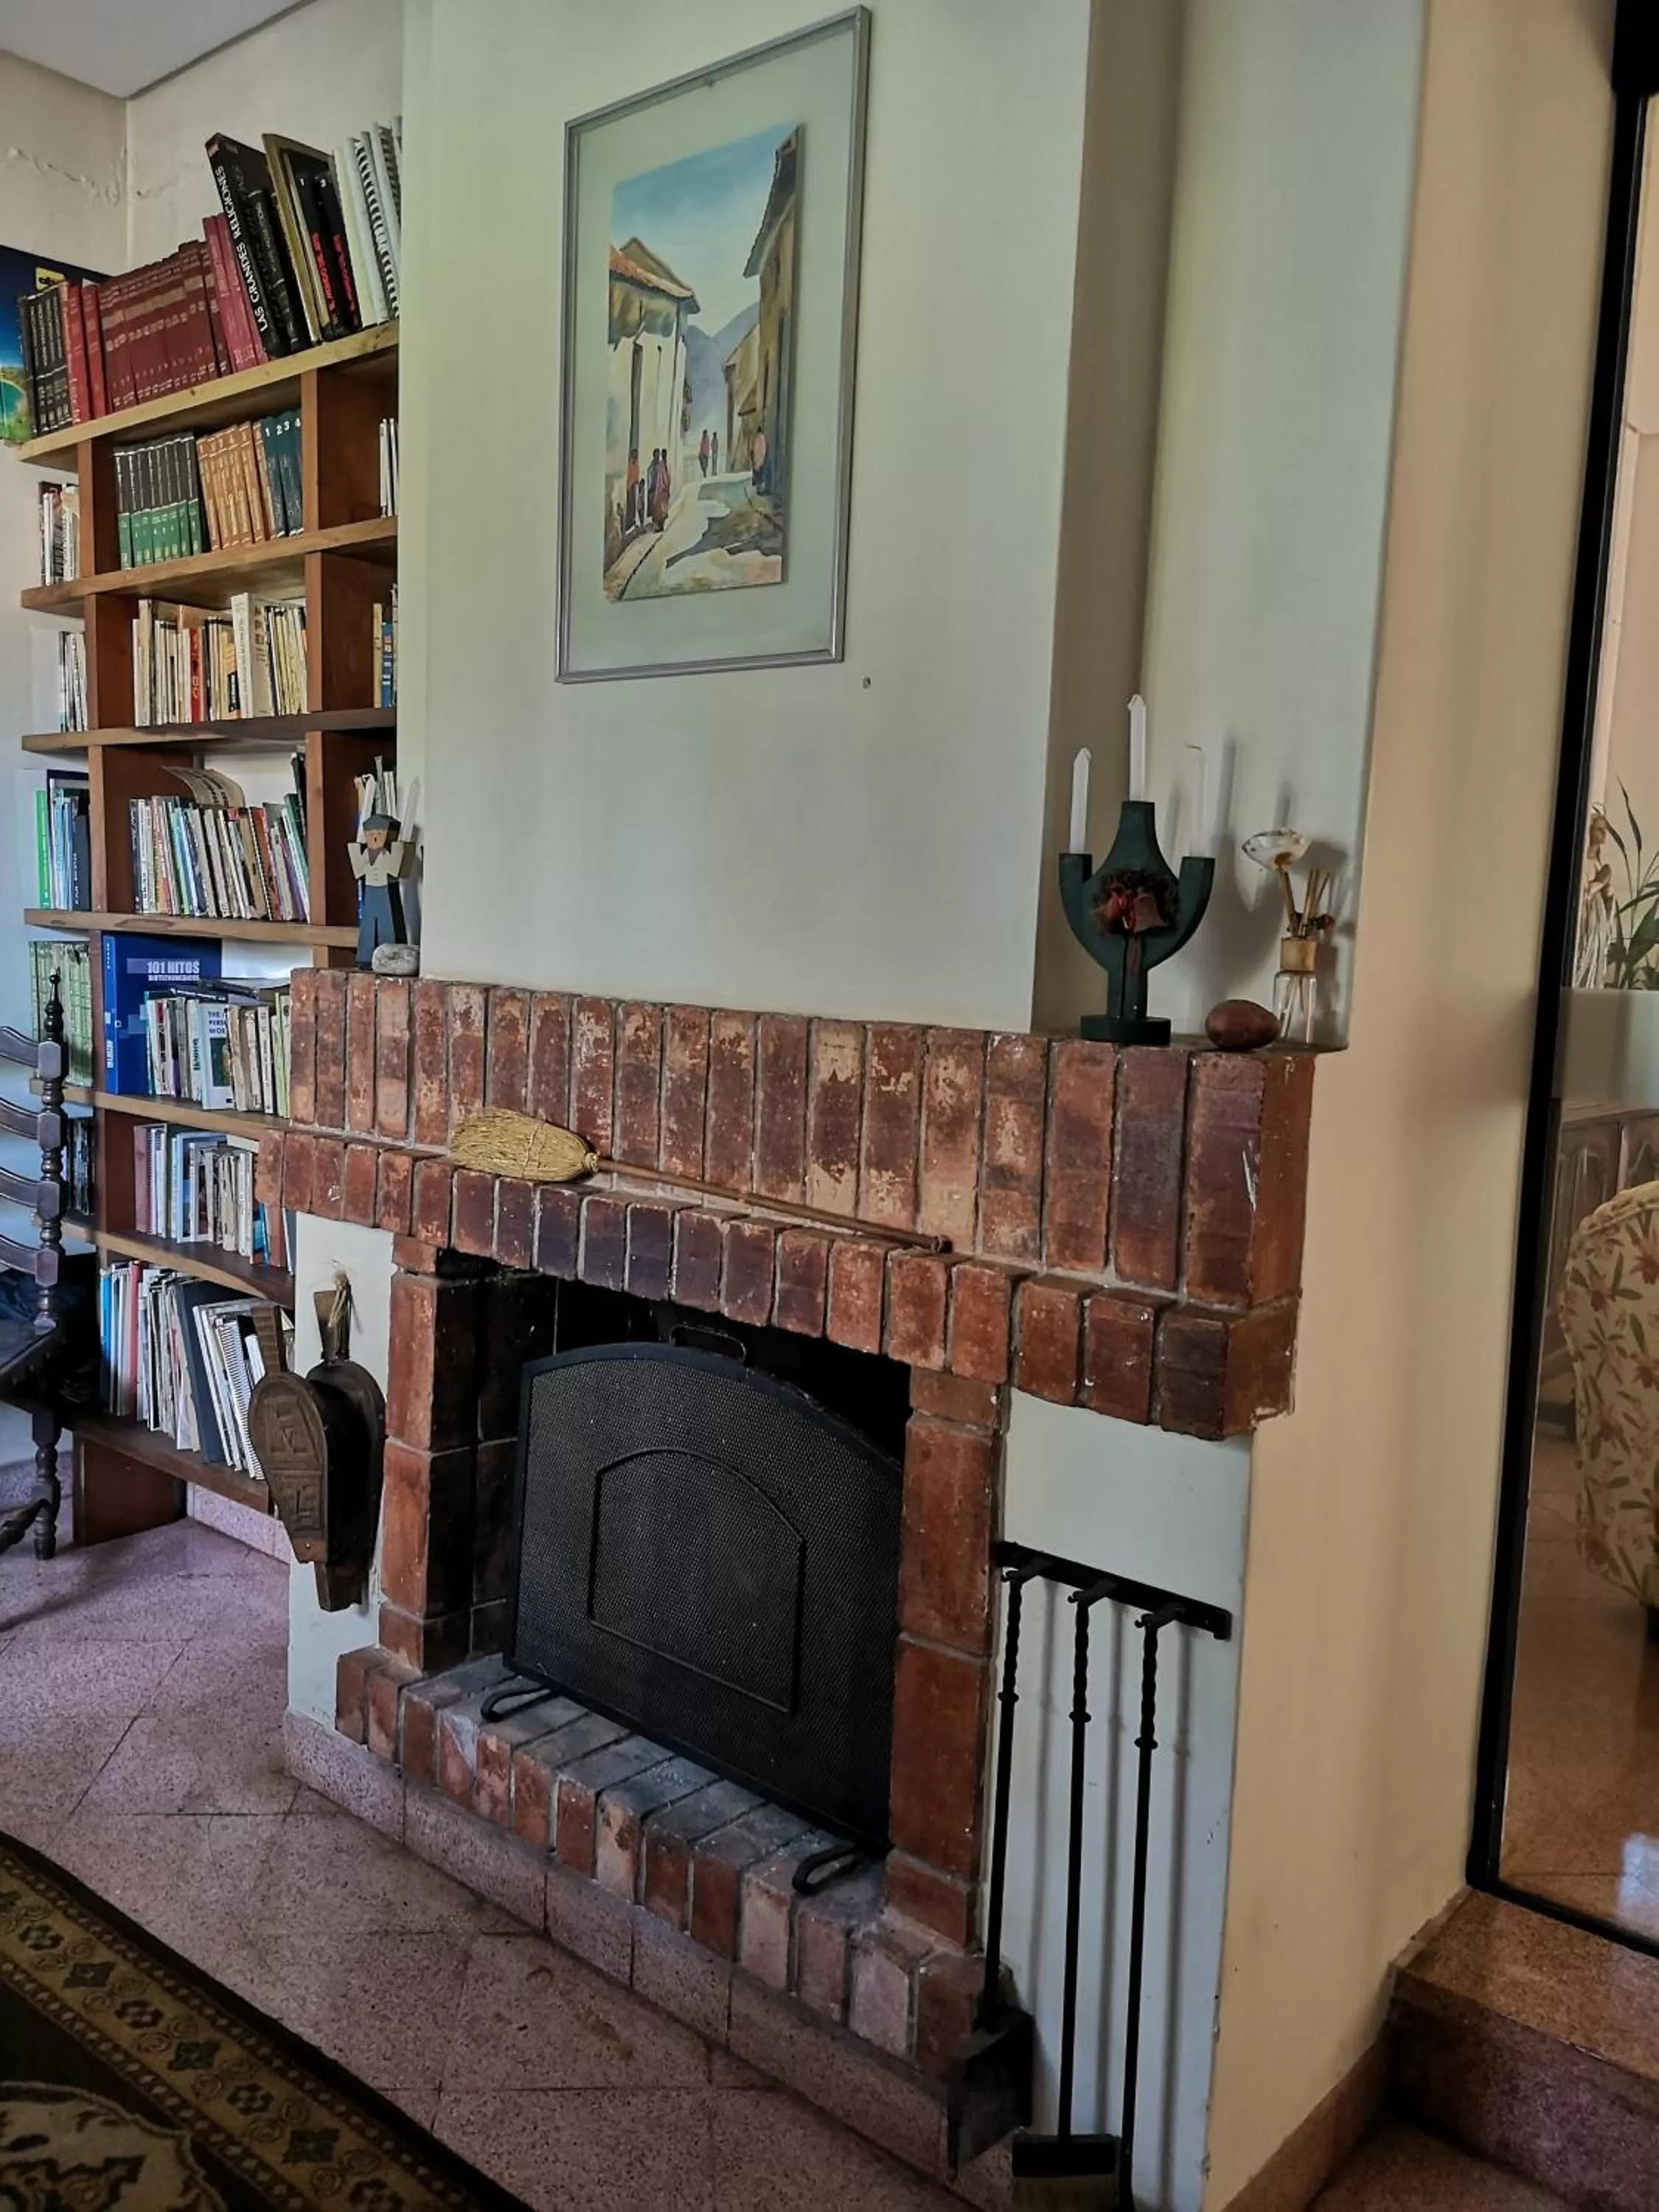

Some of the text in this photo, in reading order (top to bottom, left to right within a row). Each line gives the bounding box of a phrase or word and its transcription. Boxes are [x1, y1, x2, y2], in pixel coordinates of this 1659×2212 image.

[215, 165, 268, 333] LAS GRANDES RELIGIONES
[276, 425, 282, 436] 2
[284, 421, 290, 431] 3
[265, 428, 270, 437] 1
[147, 961, 200, 973] 101 HITOS
